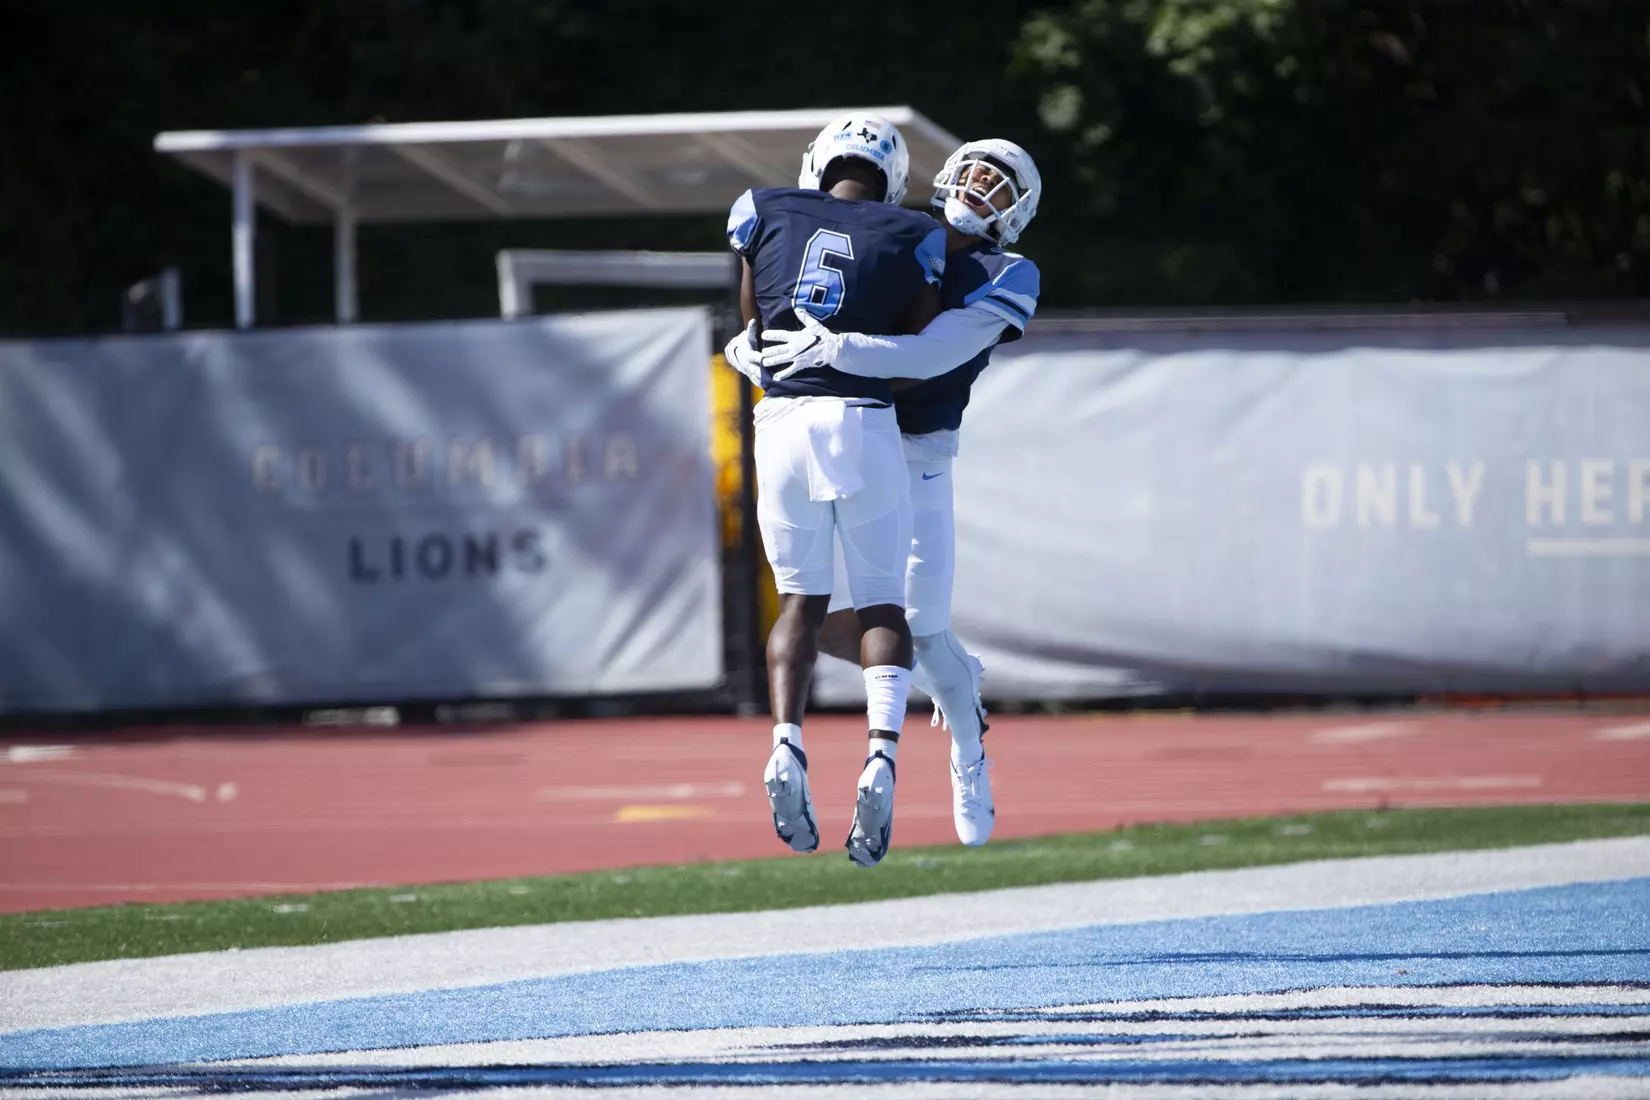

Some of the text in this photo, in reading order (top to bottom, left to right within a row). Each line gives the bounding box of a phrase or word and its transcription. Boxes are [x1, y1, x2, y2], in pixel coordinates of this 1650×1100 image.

[792, 228, 854, 321] 6
[252, 432, 640, 492] COLUMBIA
[1301, 461, 1486, 530] ONLY
[348, 528, 550, 584] LIONS
